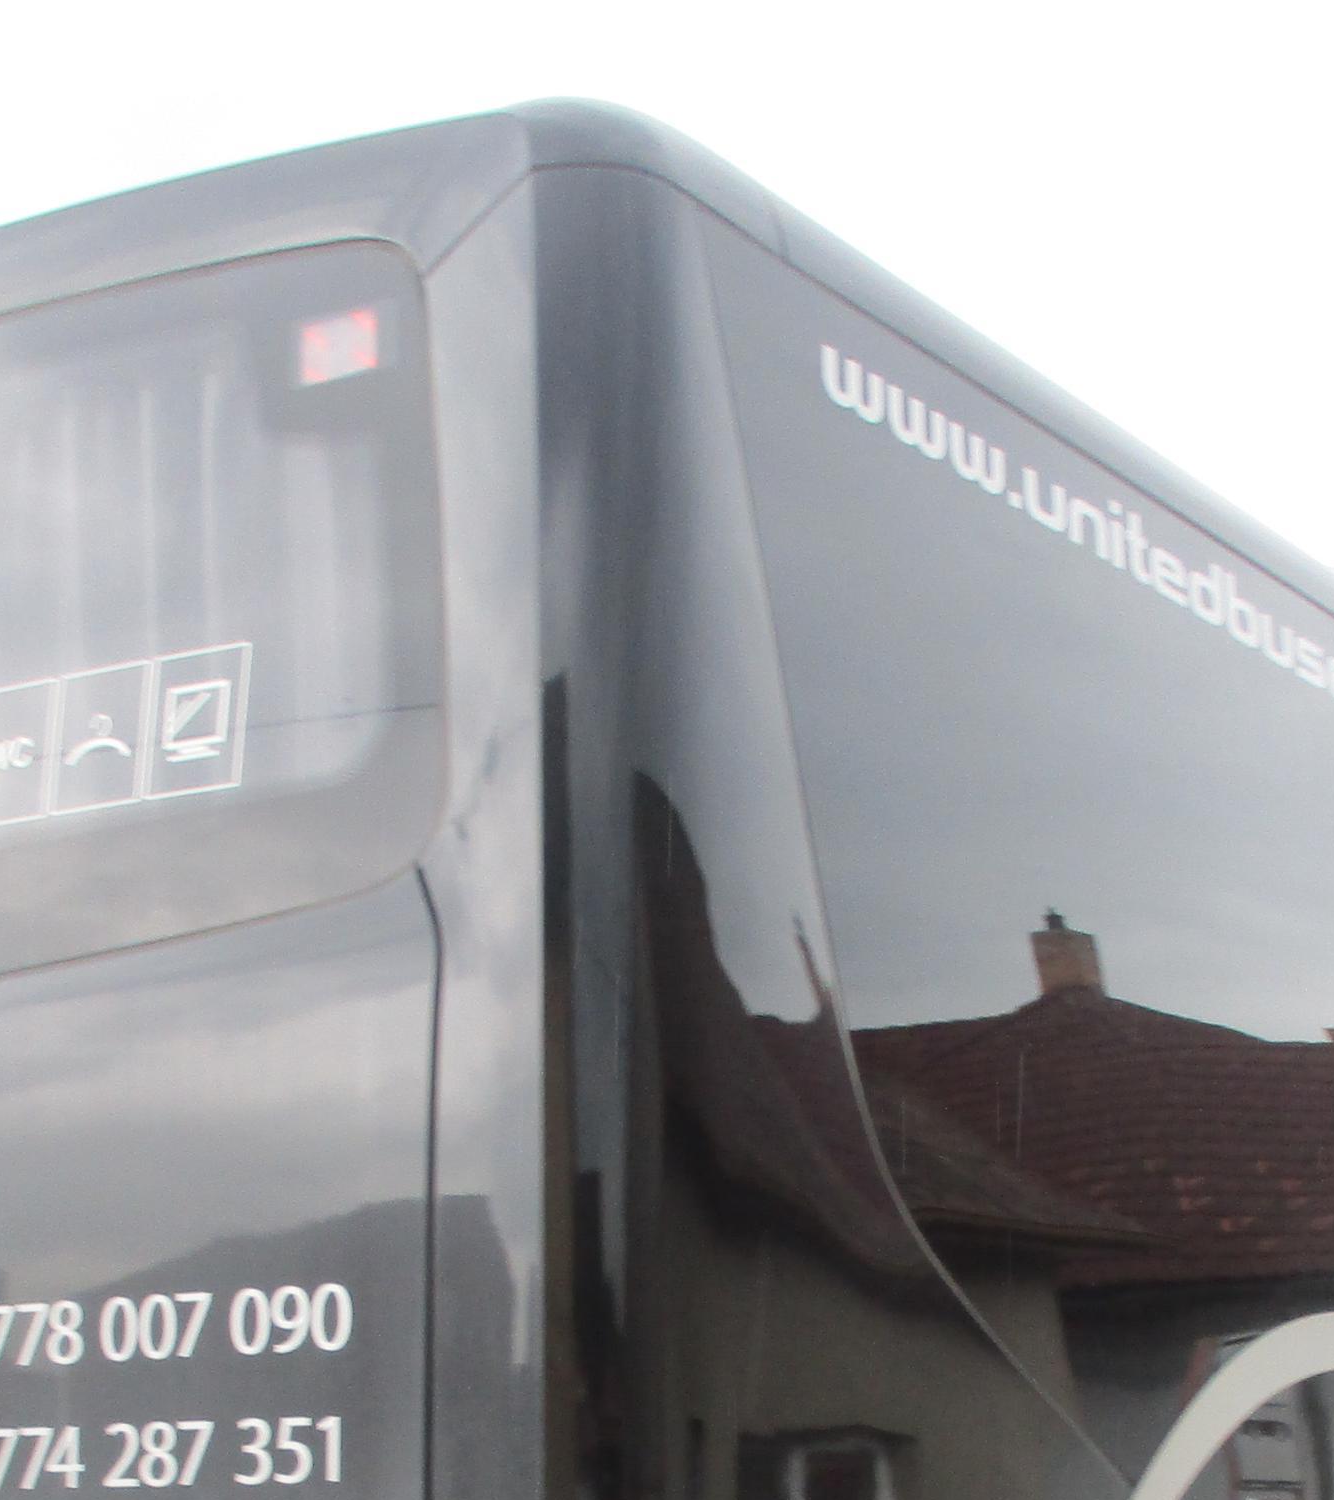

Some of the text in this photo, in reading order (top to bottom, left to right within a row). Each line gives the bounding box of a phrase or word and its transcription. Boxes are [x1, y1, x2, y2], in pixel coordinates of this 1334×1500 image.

[99, 1291, 213, 1362] 007
[228, 1282, 354, 1355] 090
[101, 1420, 215, 1489] 287
[232, 1414, 343, 1486] 351
